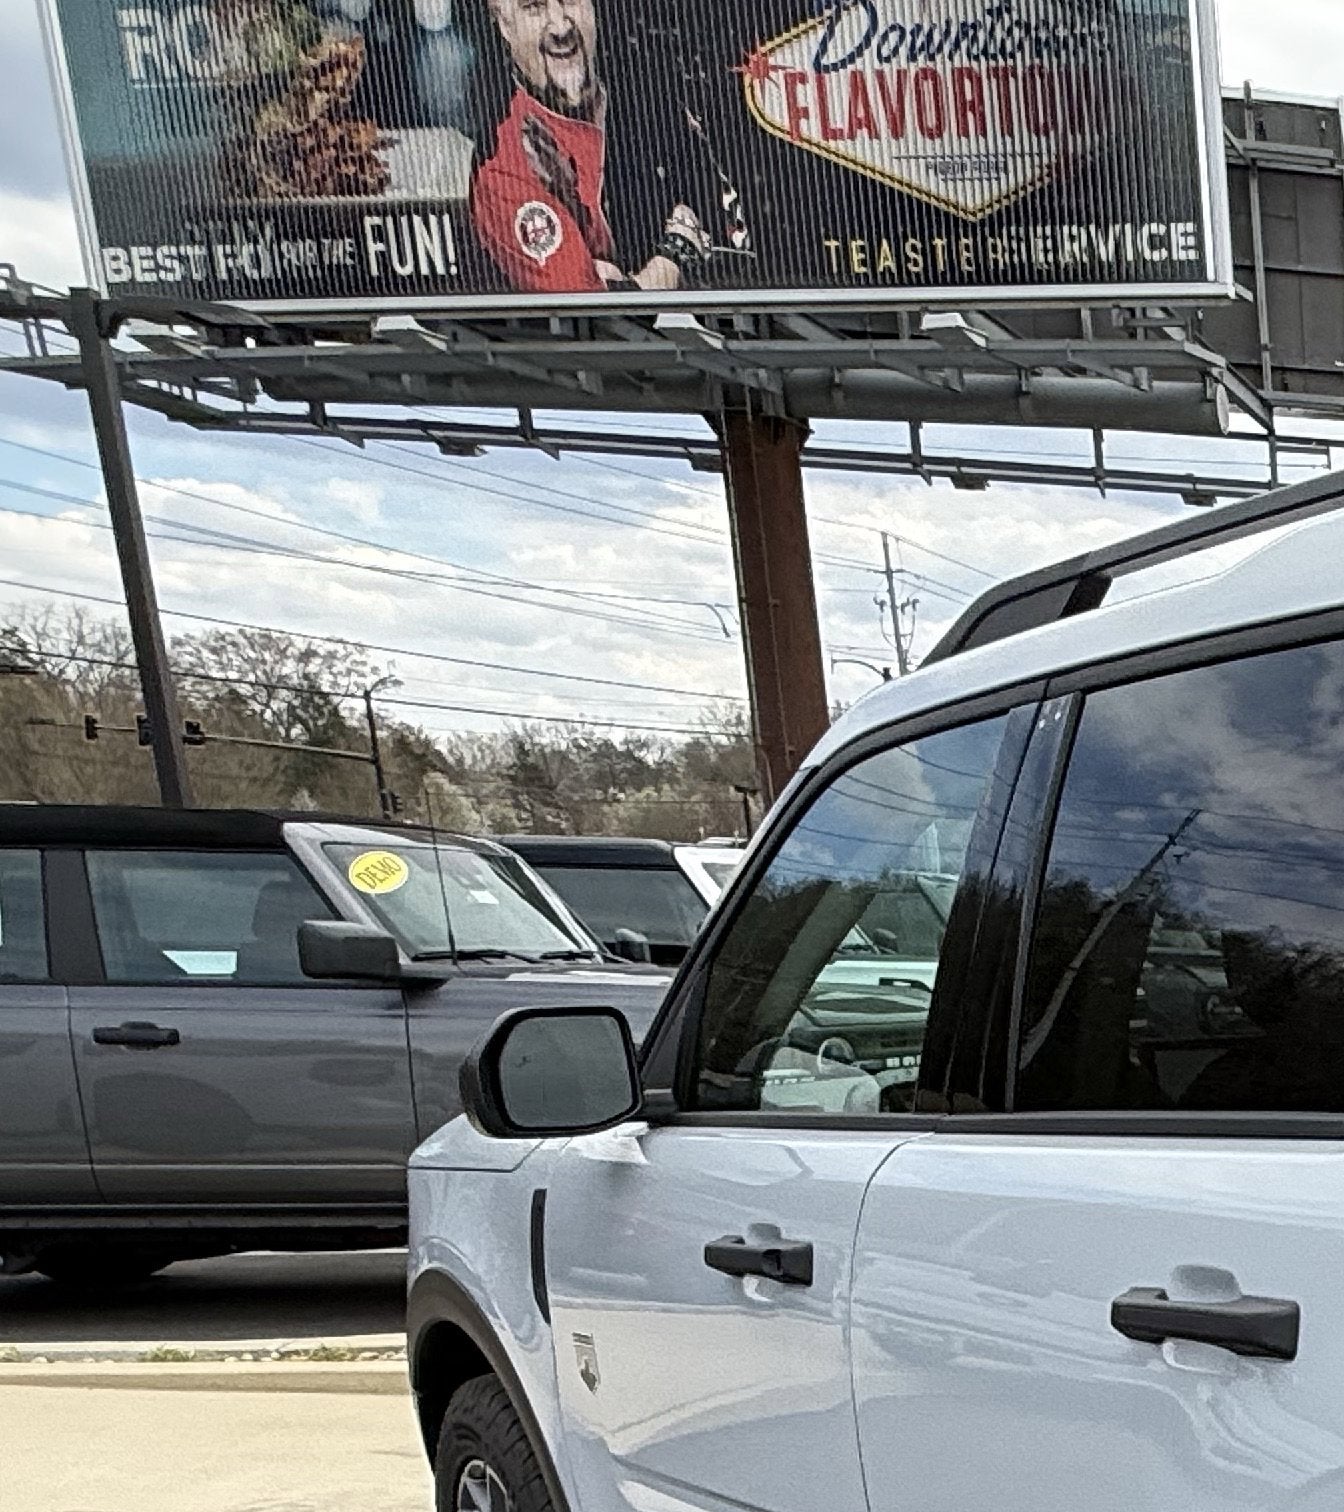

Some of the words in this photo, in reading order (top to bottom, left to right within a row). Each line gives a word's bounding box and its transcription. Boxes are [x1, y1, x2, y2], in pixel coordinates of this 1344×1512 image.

[784, 63, 1102, 142] FLAVORTO
[364, 213, 458, 277] FUN!
[355, 856, 402, 889] DEMO
